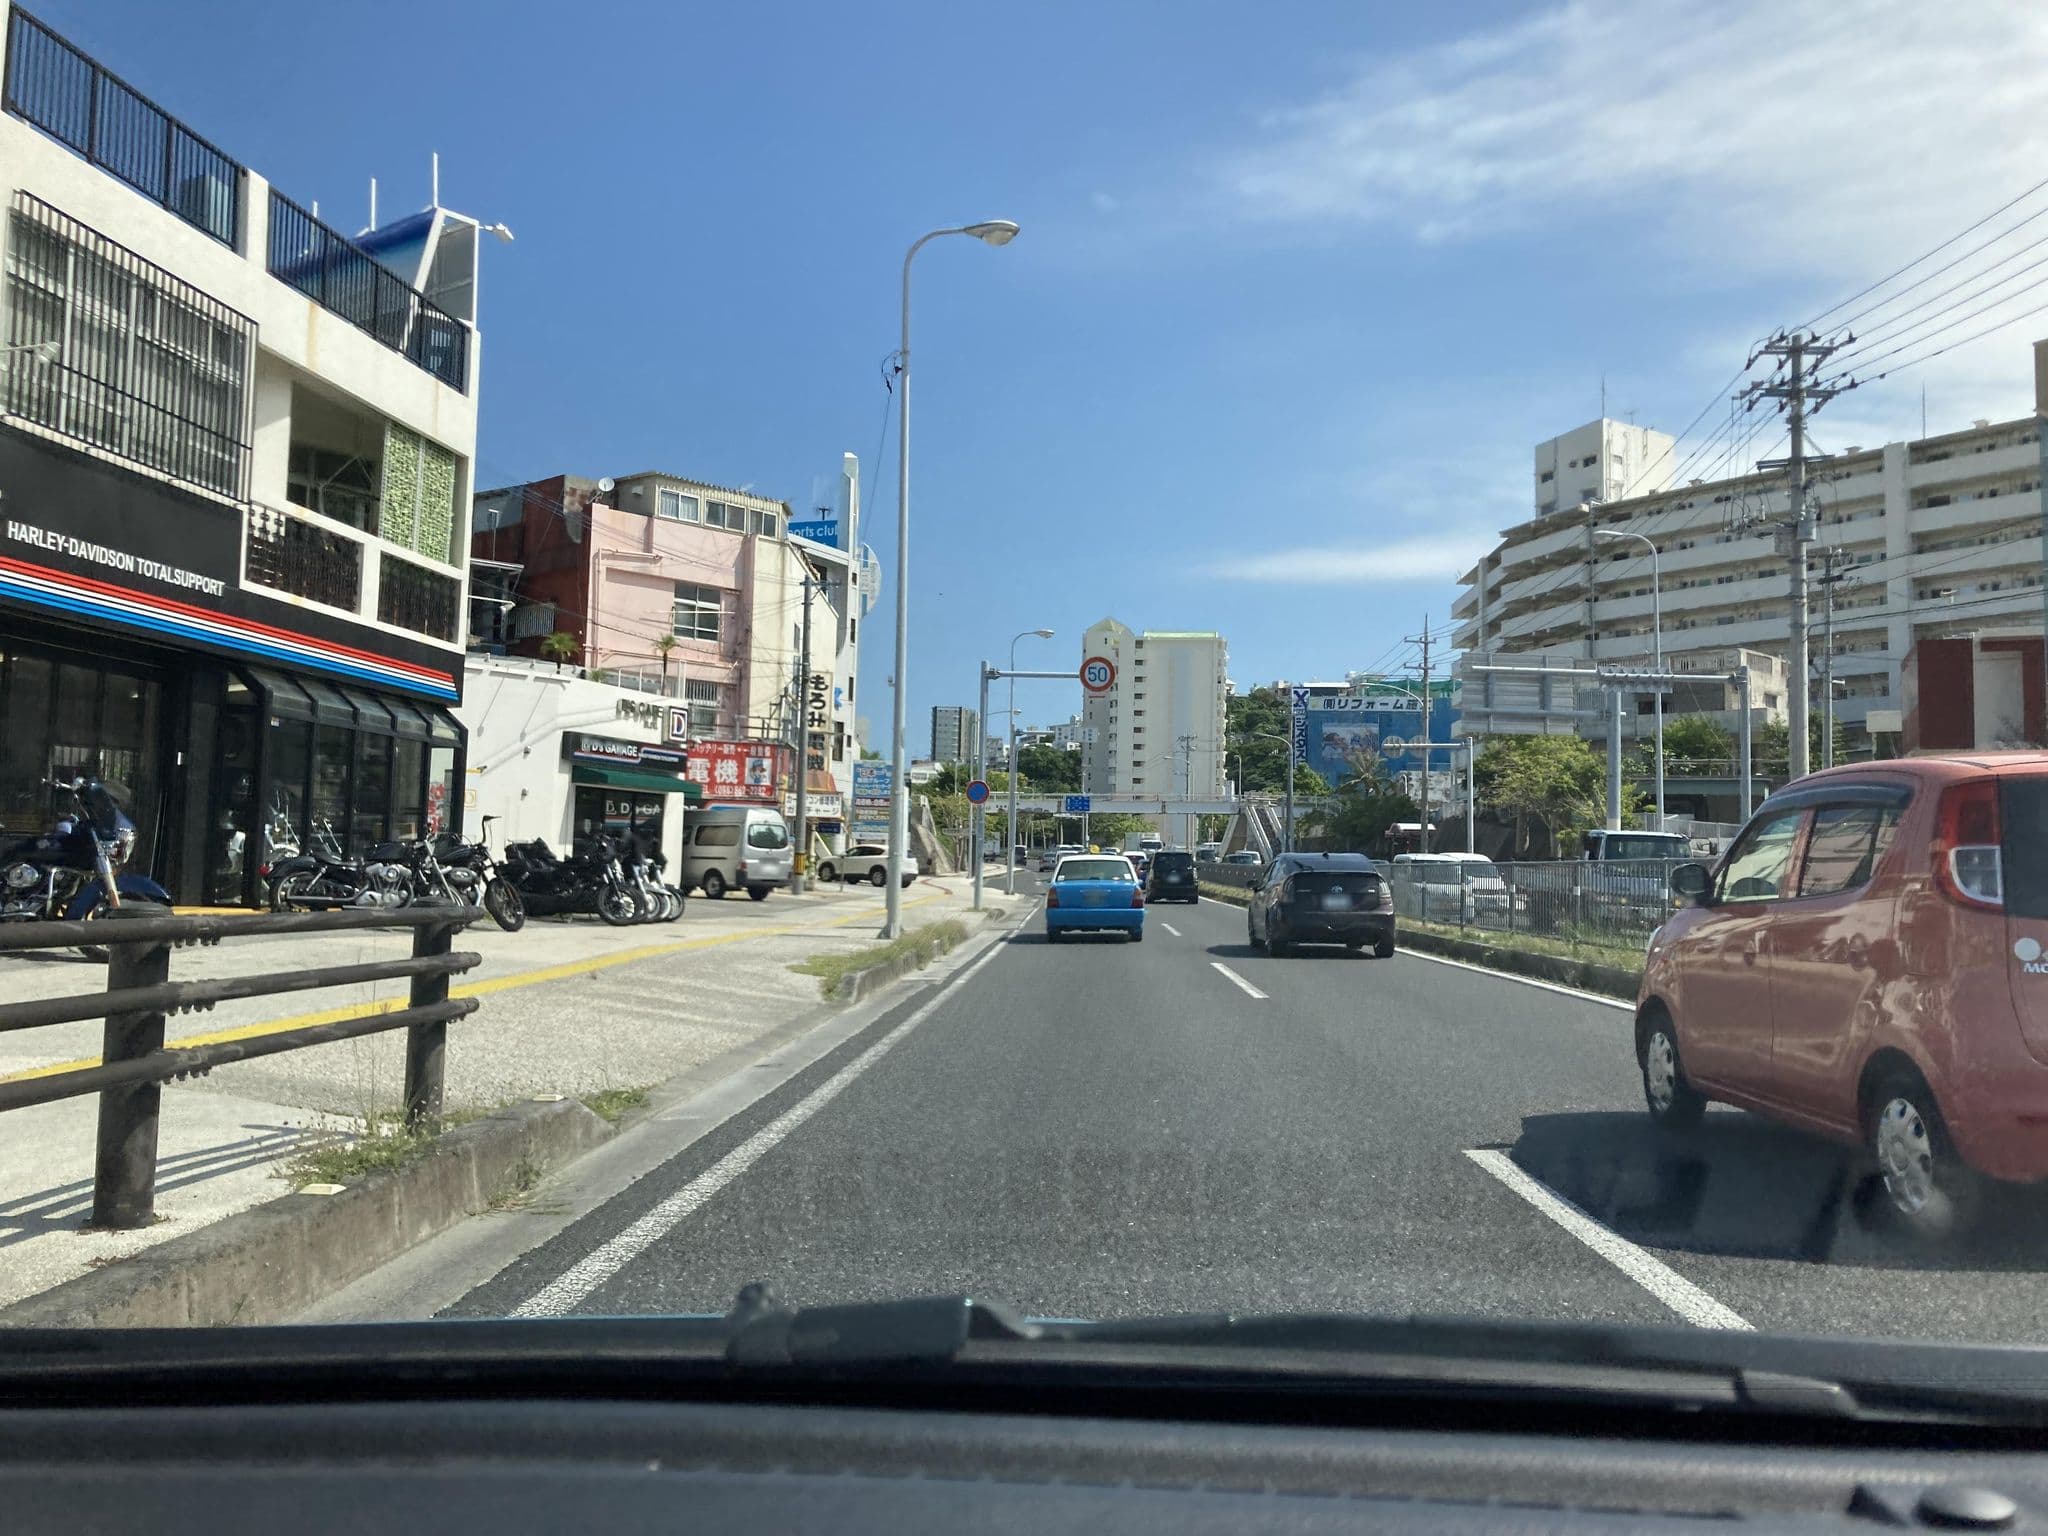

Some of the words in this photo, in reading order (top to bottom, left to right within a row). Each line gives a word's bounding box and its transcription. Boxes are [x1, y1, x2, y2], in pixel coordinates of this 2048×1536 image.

[8, 520, 134, 573] HARLEY-DAVIDSON
[137, 557, 226, 597] TOTALSUPPORT
[1088, 666, 1108, 683] 50
[672, 713, 686, 736] D
